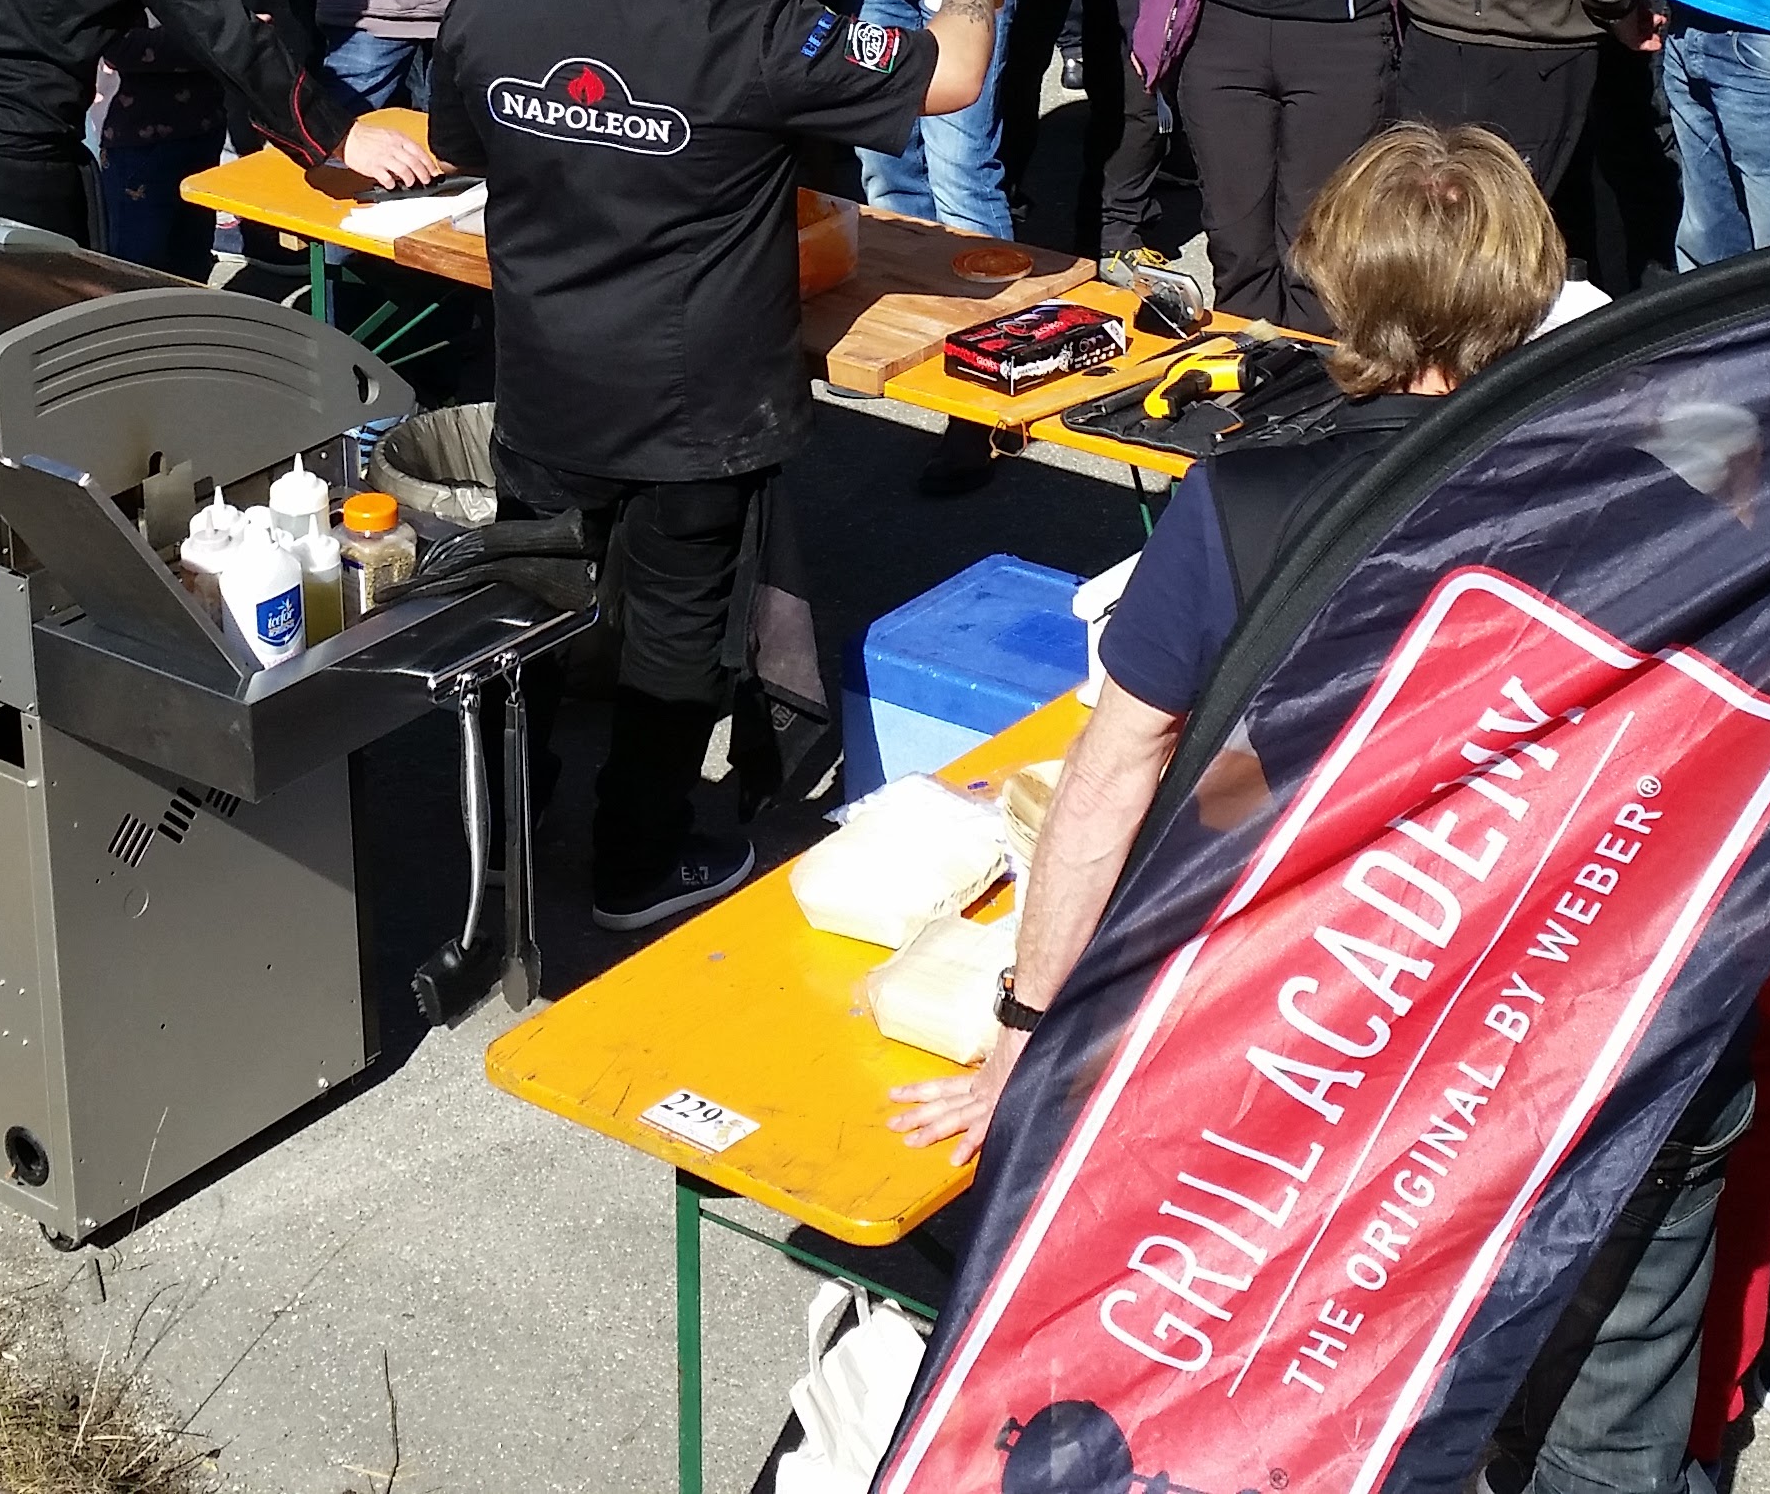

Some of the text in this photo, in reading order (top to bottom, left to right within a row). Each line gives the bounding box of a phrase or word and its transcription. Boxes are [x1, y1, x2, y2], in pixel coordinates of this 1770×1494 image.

[501, 90, 673, 144] NAPOLEON
[659, 1092, 724, 1124] 229
[1099, 675, 1587, 1373] GRILL ACADEMY
[1282, 1299, 1365, 1394] THE
[1345, 1061, 1506, 1292] ORIGINAL
[1484, 971, 1546, 1044] BY
